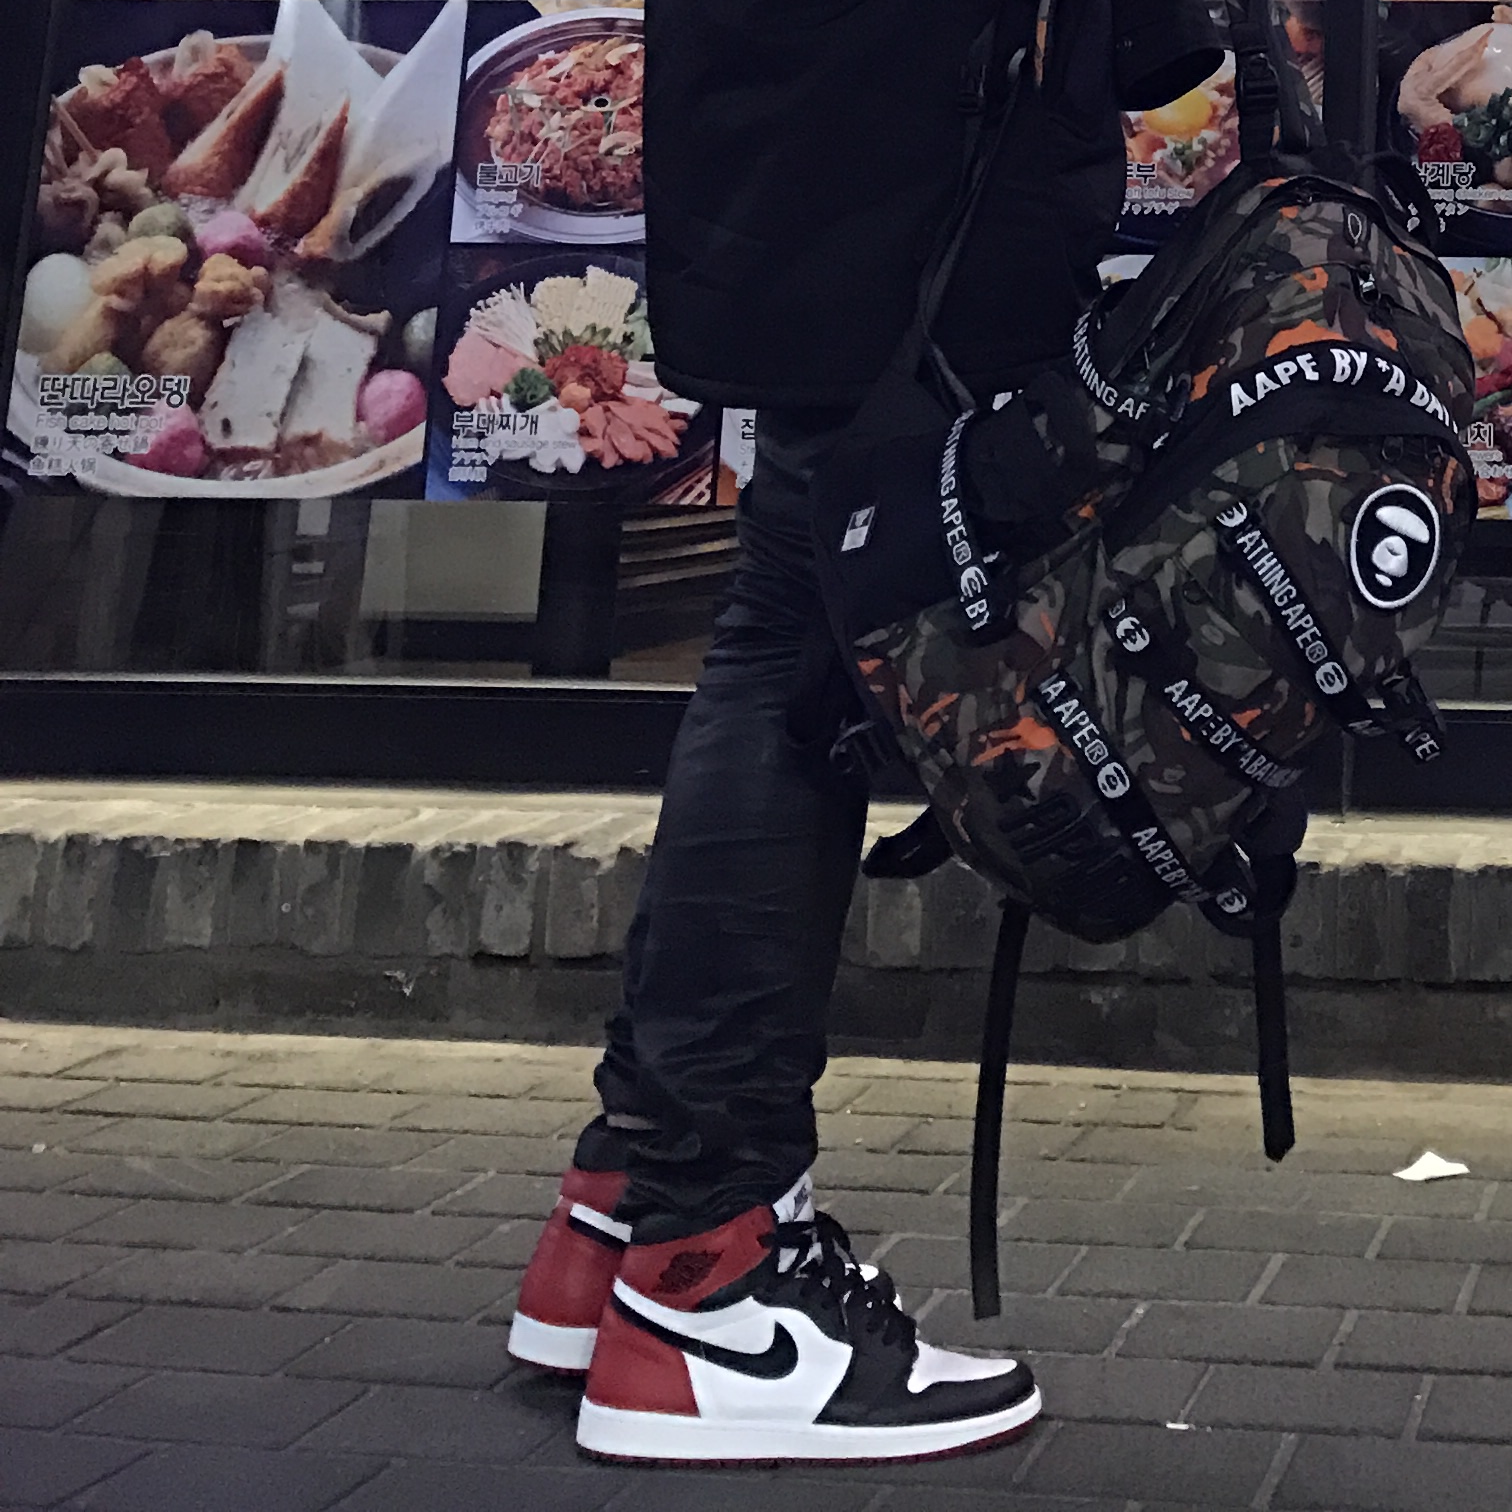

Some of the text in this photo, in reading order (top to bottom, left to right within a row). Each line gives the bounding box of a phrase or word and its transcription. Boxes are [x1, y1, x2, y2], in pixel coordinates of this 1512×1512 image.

[478, 164, 542, 187] 불고기
[39, 375, 189, 409] 딴따라오뎅
[1230, 352, 1320, 417] AAPE
[1329, 348, 1368, 386] BY
[453, 412, 540, 436] 부대찌개
